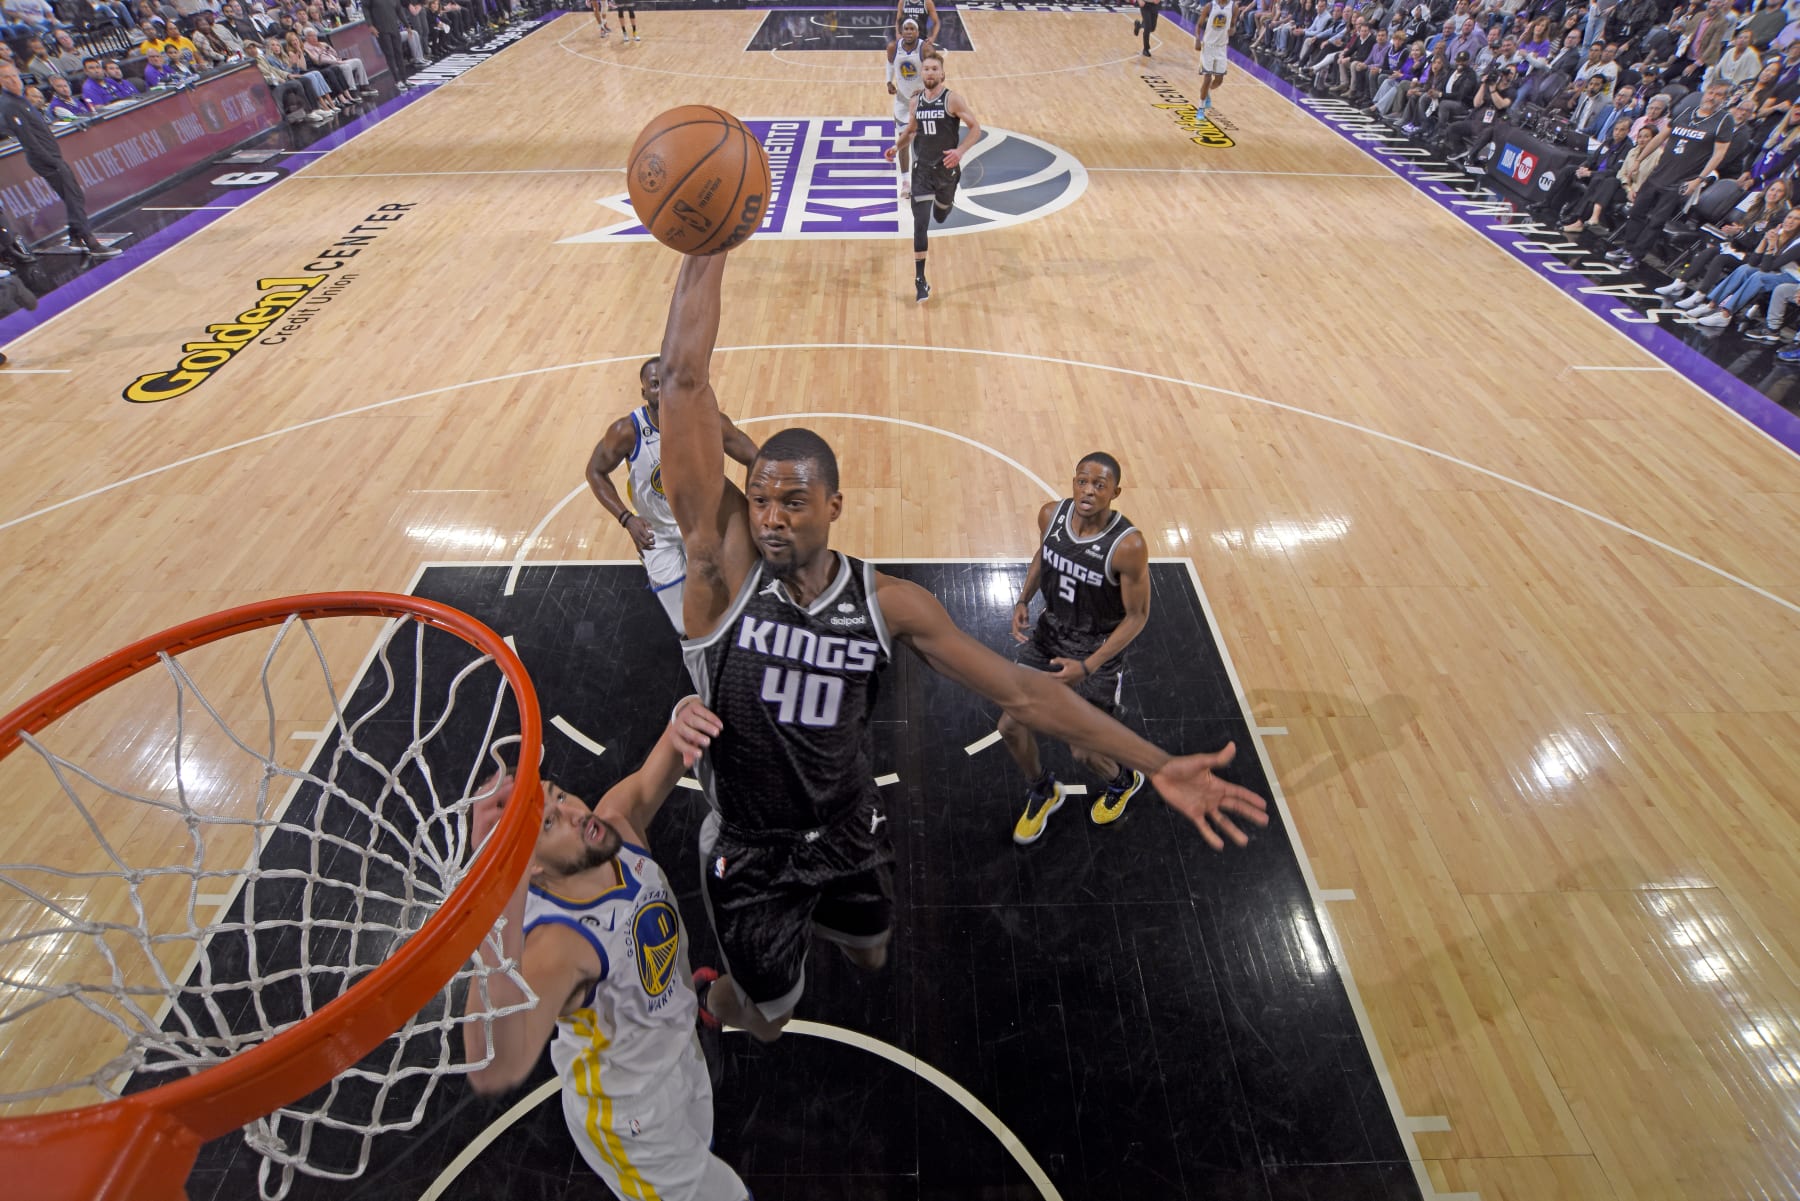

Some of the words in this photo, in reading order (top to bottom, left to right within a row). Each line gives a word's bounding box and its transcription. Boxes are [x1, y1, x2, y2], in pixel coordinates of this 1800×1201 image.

[916, 110, 945, 119] KINGS
[922, 121, 937, 135] 10
[1671, 126, 1707, 140] KINGS
[74, 156, 105, 188] ALL
[93, 147, 124, 178] THE
[114, 136, 150, 170] TIME
[800, 120, 900, 233] KINGS
[303, 202, 418, 272] CENTER
[1372, 147, 1699, 324] SACRAMENTO
[260, 308, 322, 346] Credit
[305, 273, 360, 305] Union
[1043, 543, 1105, 587] KINGS
[1058, 574, 1077, 603] 5
[738, 615, 880, 672] KINGS
[761, 666, 845, 728] 40
